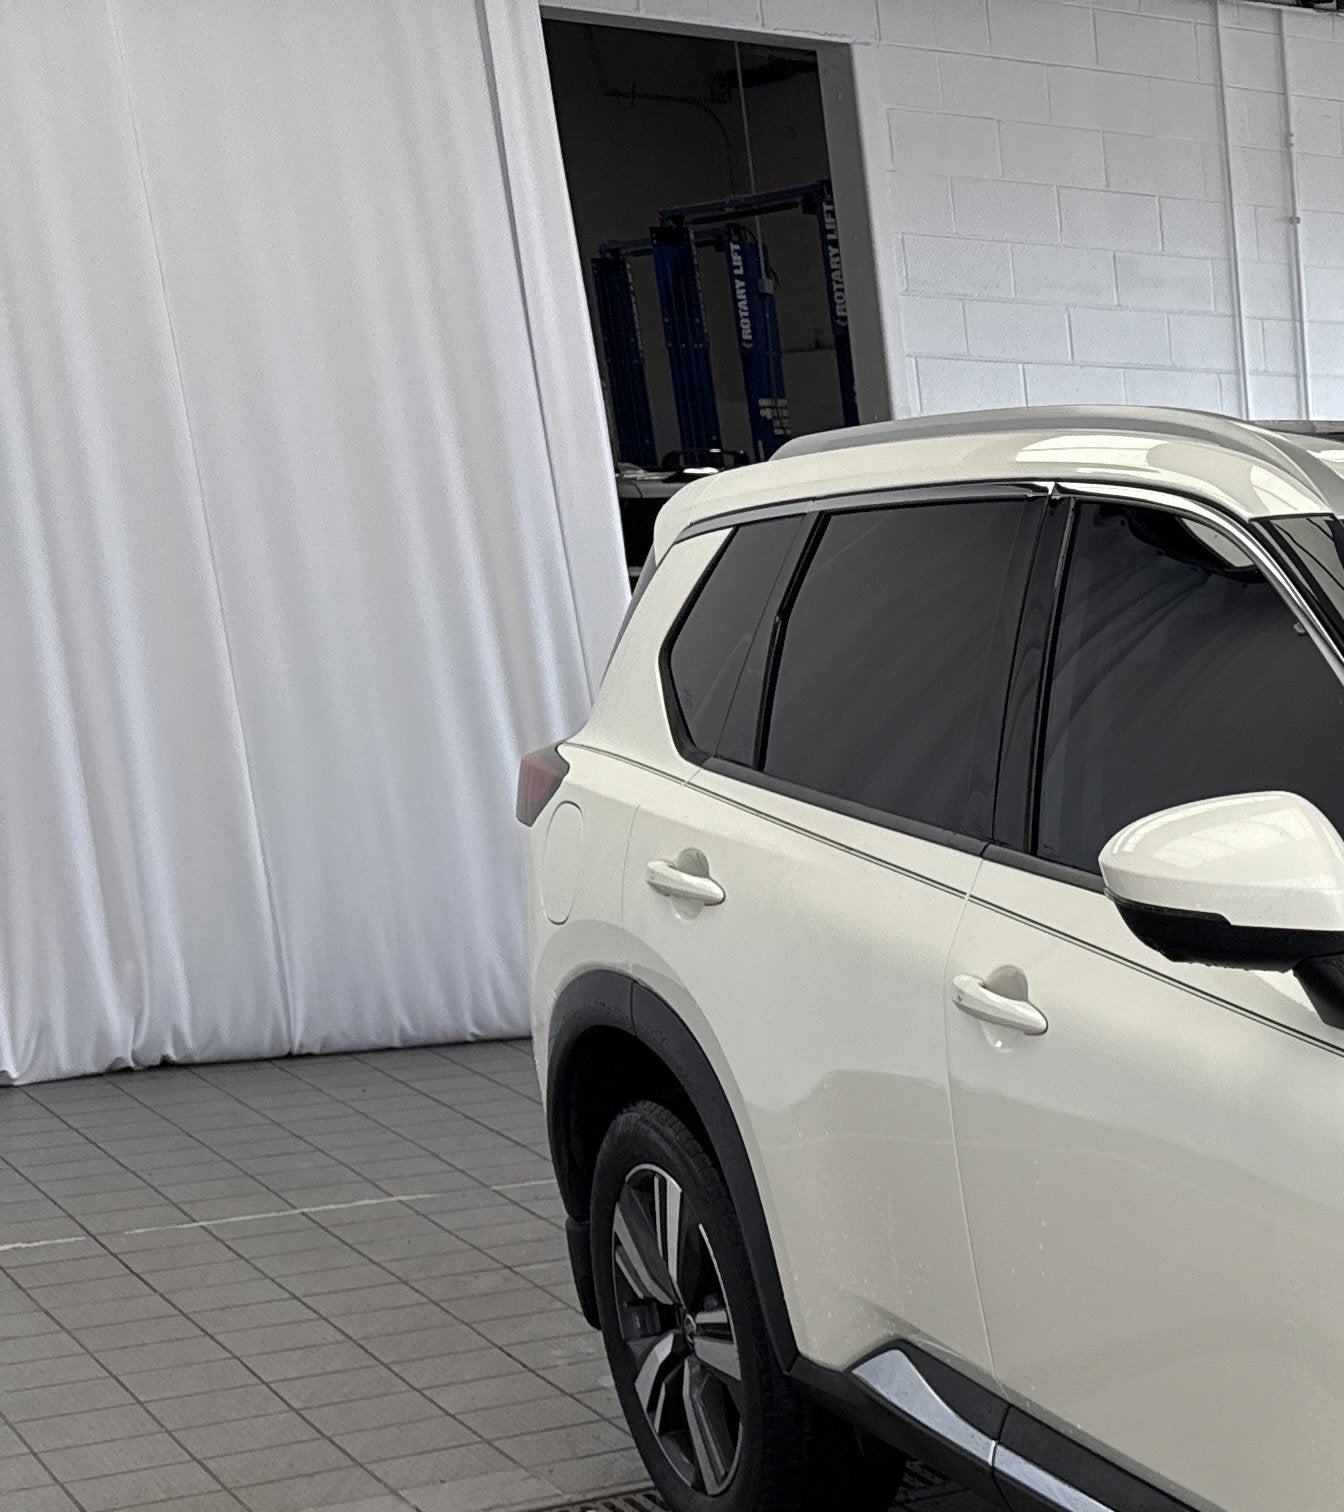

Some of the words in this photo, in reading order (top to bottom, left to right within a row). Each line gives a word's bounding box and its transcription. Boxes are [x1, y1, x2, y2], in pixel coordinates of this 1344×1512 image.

[823, 201, 838, 240] LIFT
[730, 242, 744, 274] LIFT
[828, 245, 848, 317] ROTARY
[735, 279, 753, 340] ROTARY
